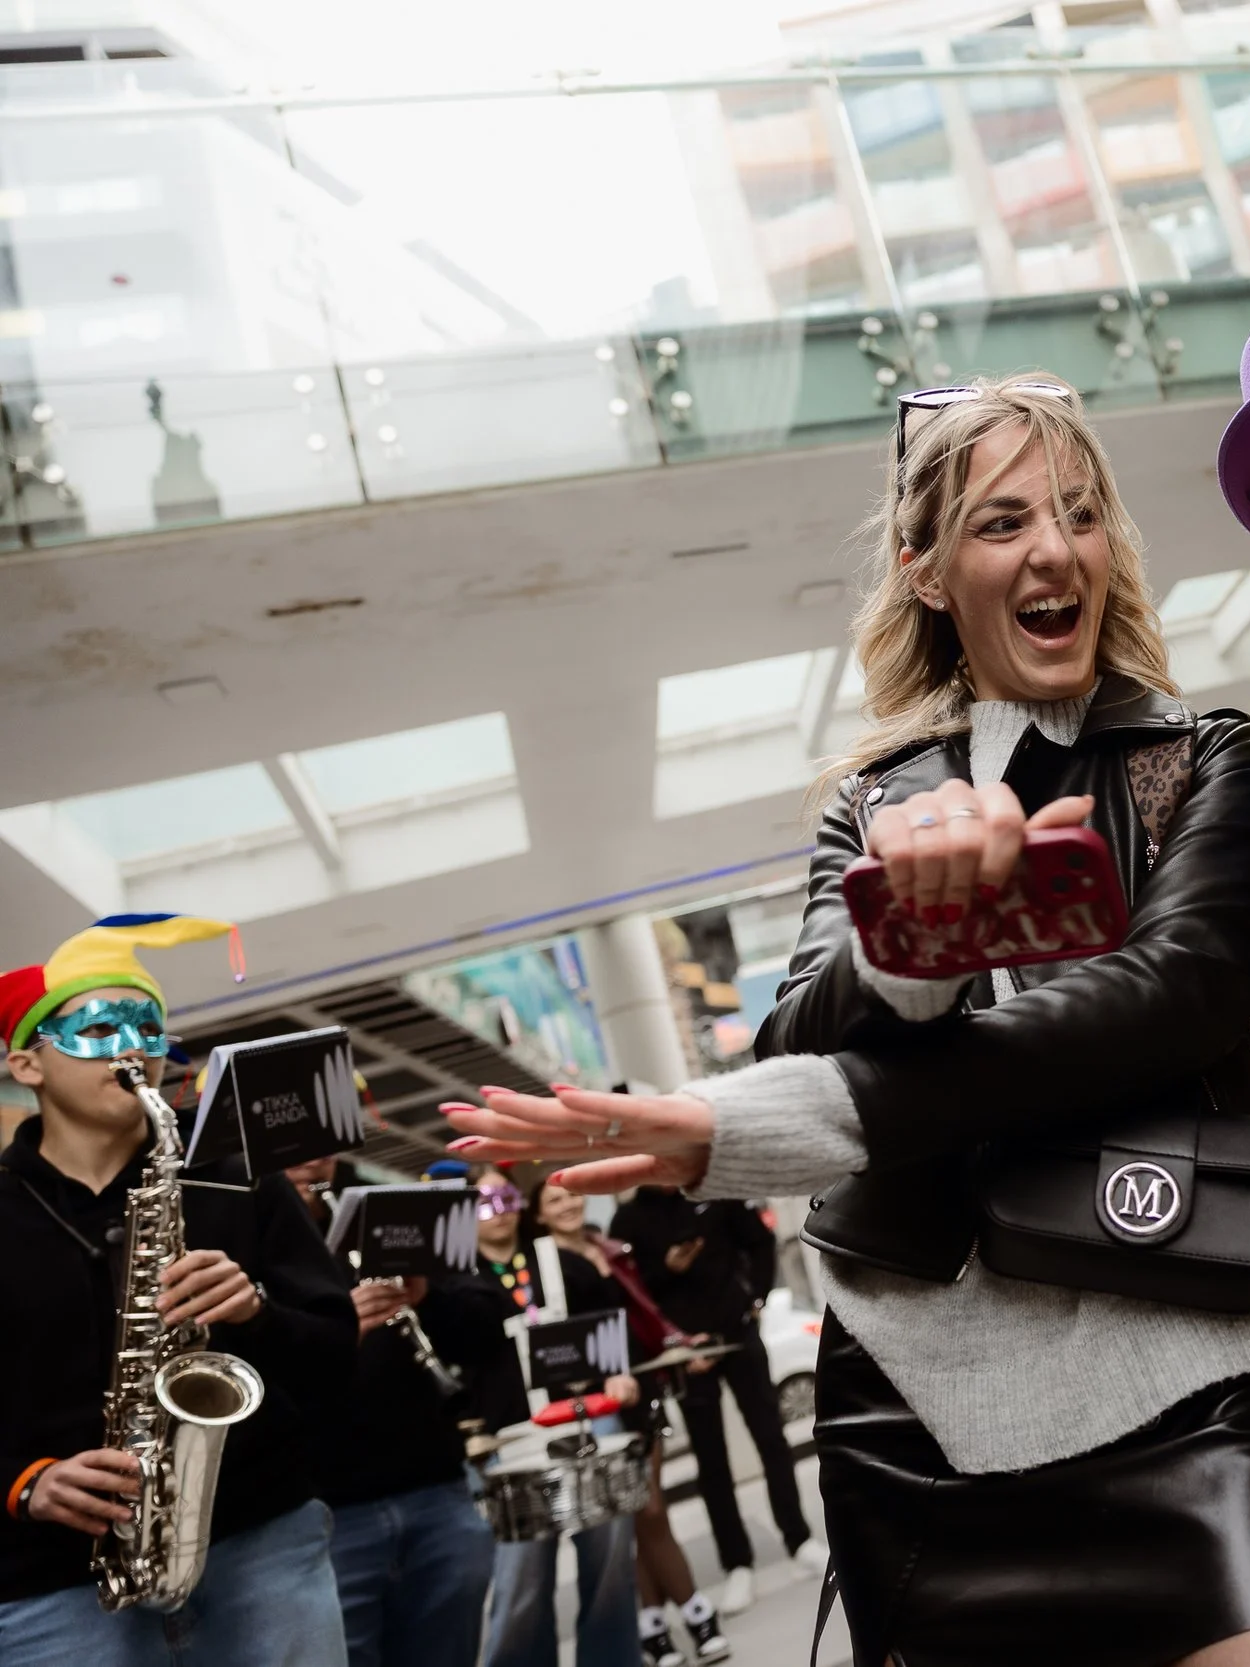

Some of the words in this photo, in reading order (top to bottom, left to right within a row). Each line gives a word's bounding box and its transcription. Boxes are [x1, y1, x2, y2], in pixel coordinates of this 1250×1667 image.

[264, 1092, 301, 1112] TIKKA
[264, 1105, 309, 1129] BANDA
[1119, 1173, 1168, 1219] M
